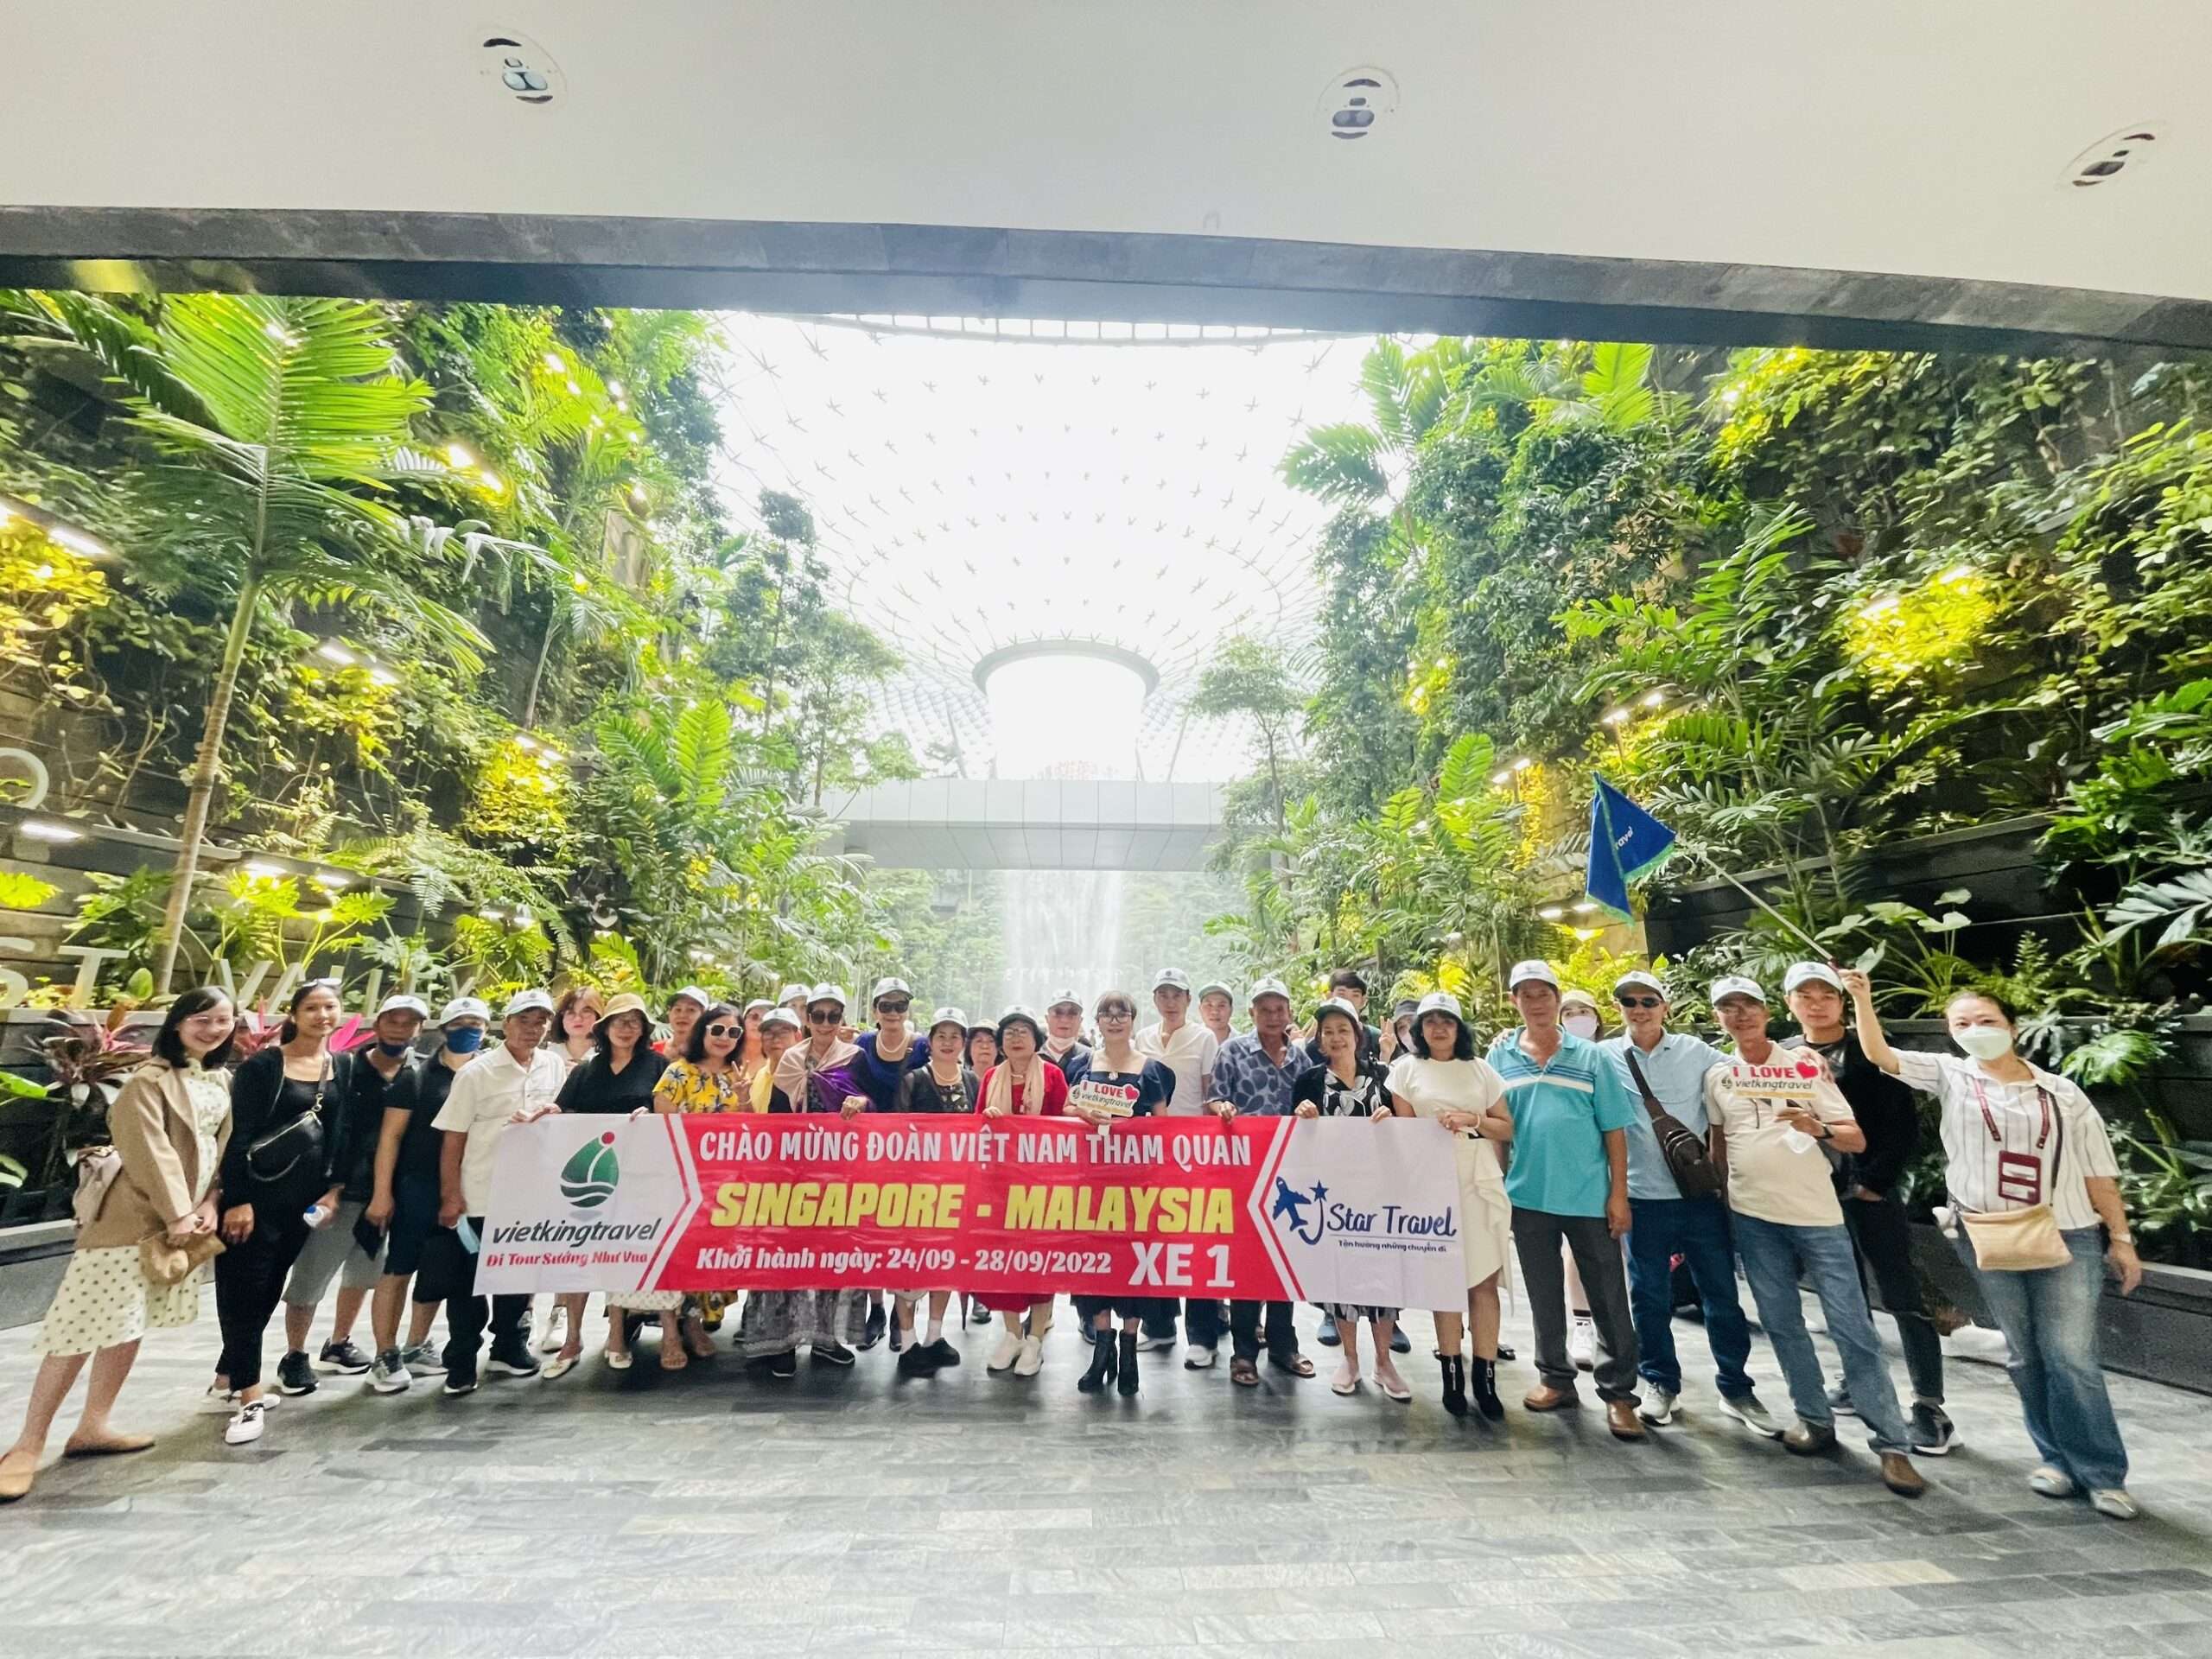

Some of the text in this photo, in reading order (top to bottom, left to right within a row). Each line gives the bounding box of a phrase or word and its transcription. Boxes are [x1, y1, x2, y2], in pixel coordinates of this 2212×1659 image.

[1733, 1066, 1796, 1079] I LOVE
[1735, 1078, 1813, 1091] vietkingtravel
[1083, 1081, 1123, 1098] I LOVE
[700, 1123, 1251, 1173] CHÀO MỪNG ĐOÀN VIỆT NAM THAM QUAN
[710, 1182, 965, 1229] SINGAPORE
[1004, 1184, 1234, 1234] MALAYSIA
[1326, 1203, 1457, 1237] Star Travel
[493, 1217, 662, 1248] vietkingtravel
[508, 1253, 541, 1266] Tour
[623, 1251, 648, 1263] Vua
[696, 1244, 753, 1268] Khởi
[755, 1247, 815, 1268] hành
[819, 1247, 882, 1274] ngày:
[886, 1248, 956, 1272] 24/09
[974, 1249, 1111, 1275] 28/09/2022
[1128, 1242, 1236, 1287] XE 1
